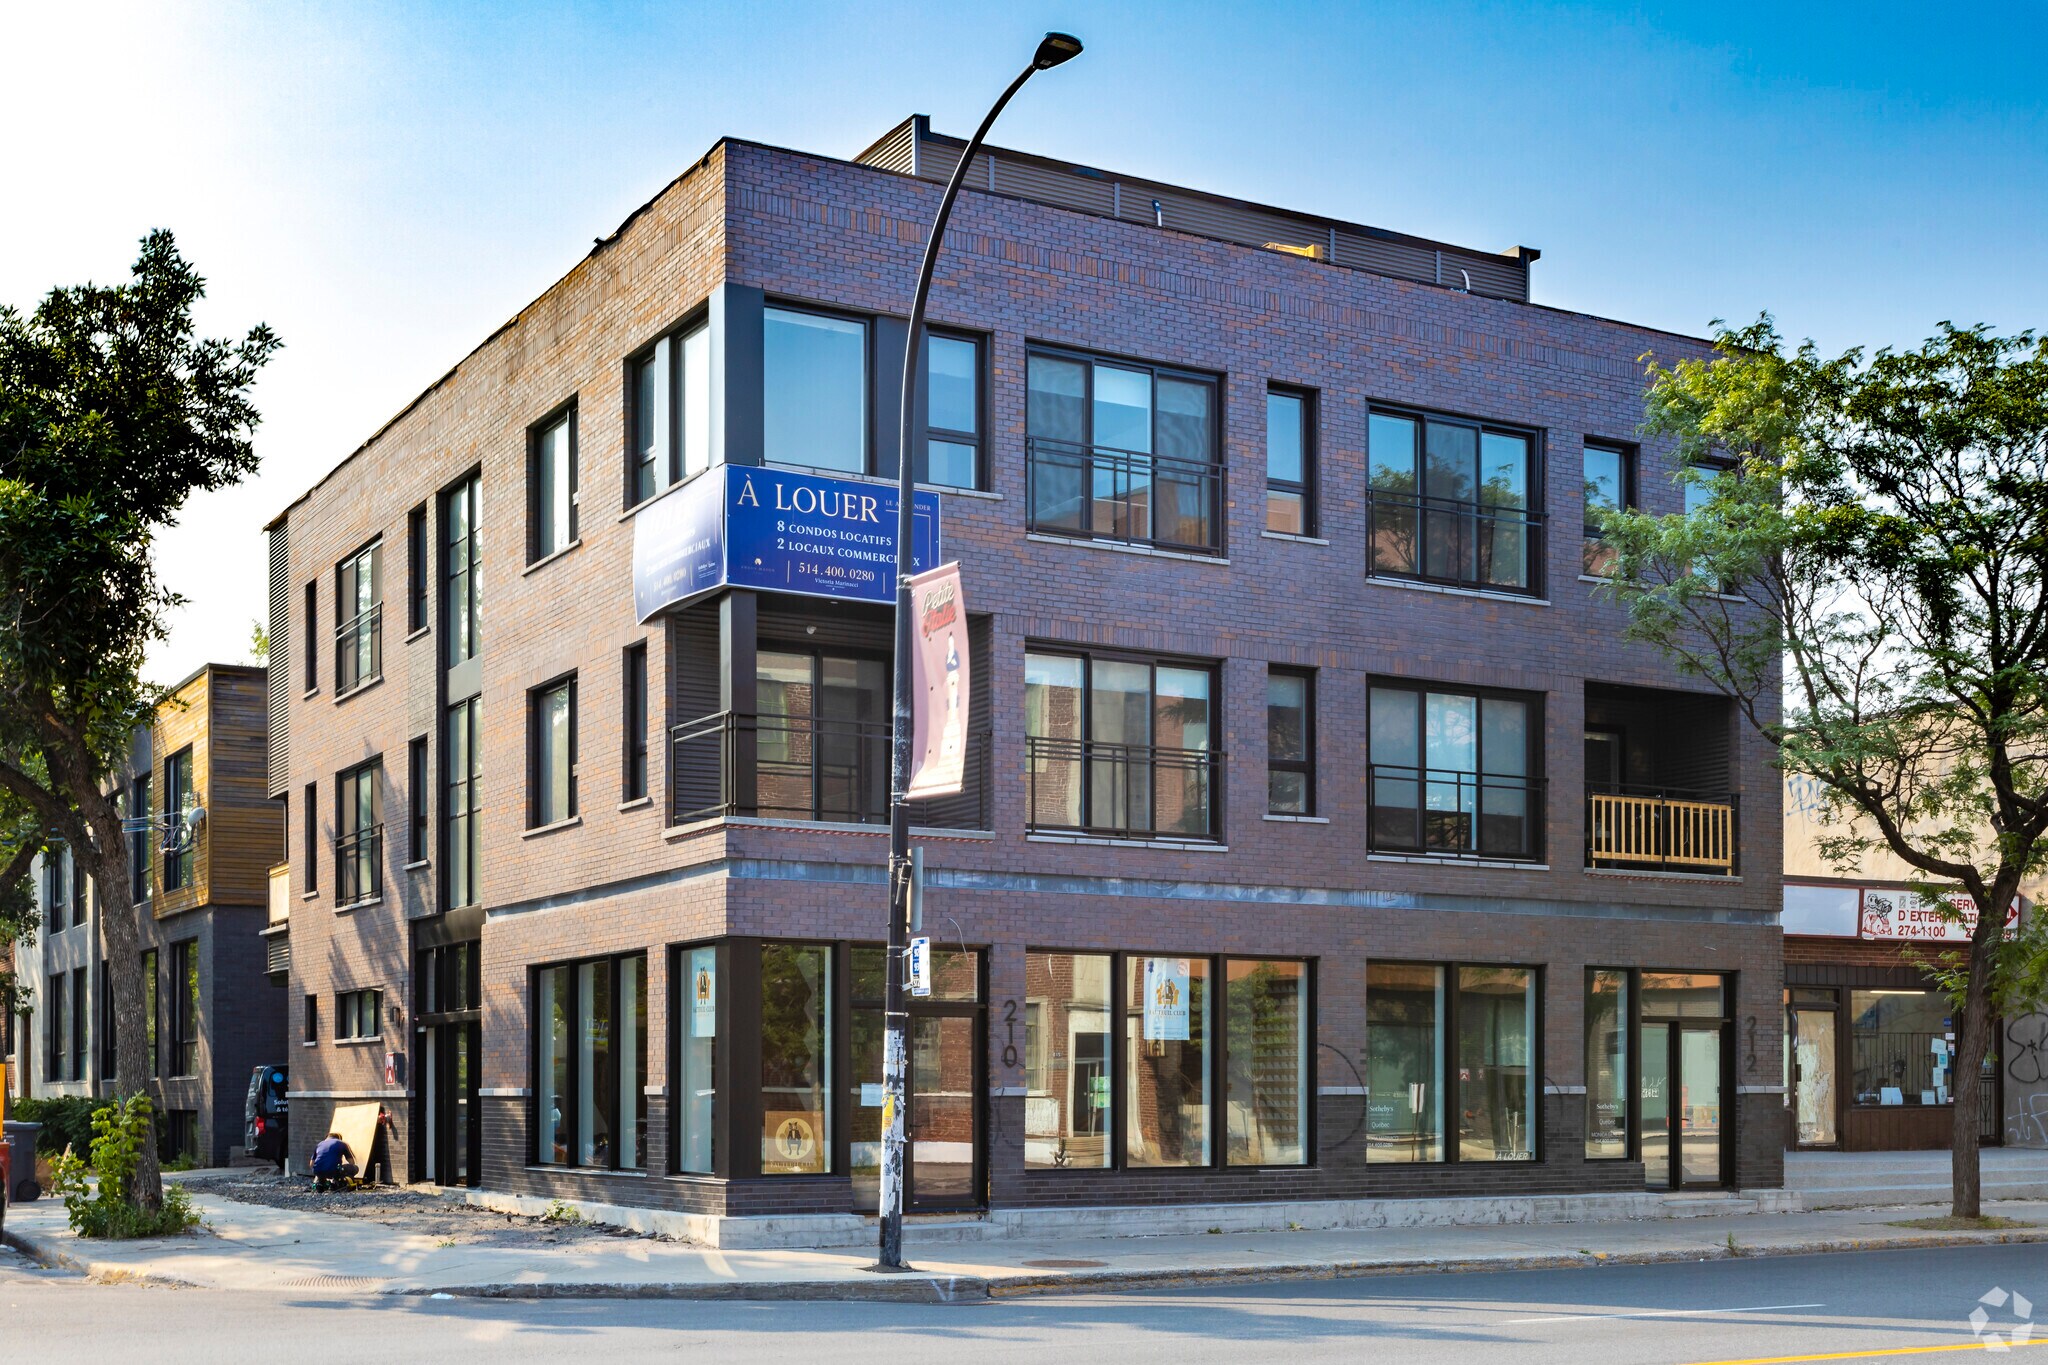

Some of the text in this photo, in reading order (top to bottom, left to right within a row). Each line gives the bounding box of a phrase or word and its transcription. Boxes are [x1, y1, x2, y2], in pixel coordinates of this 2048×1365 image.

[737, 474, 880, 524] À LOUER
[777, 520, 892, 546] 8 CONDOS LOCATIFS
[777, 538, 921, 567] 2 LOCAUX COMMERCIX
[922, 581, 955, 618] Petite
[1898, 925, 1946, 938] 274-1100
[1003, 1000, 1018, 1067] 210
[1746, 1015, 1757, 1072] 212
[1369, 1105, 1394, 1113] Sotheby's
